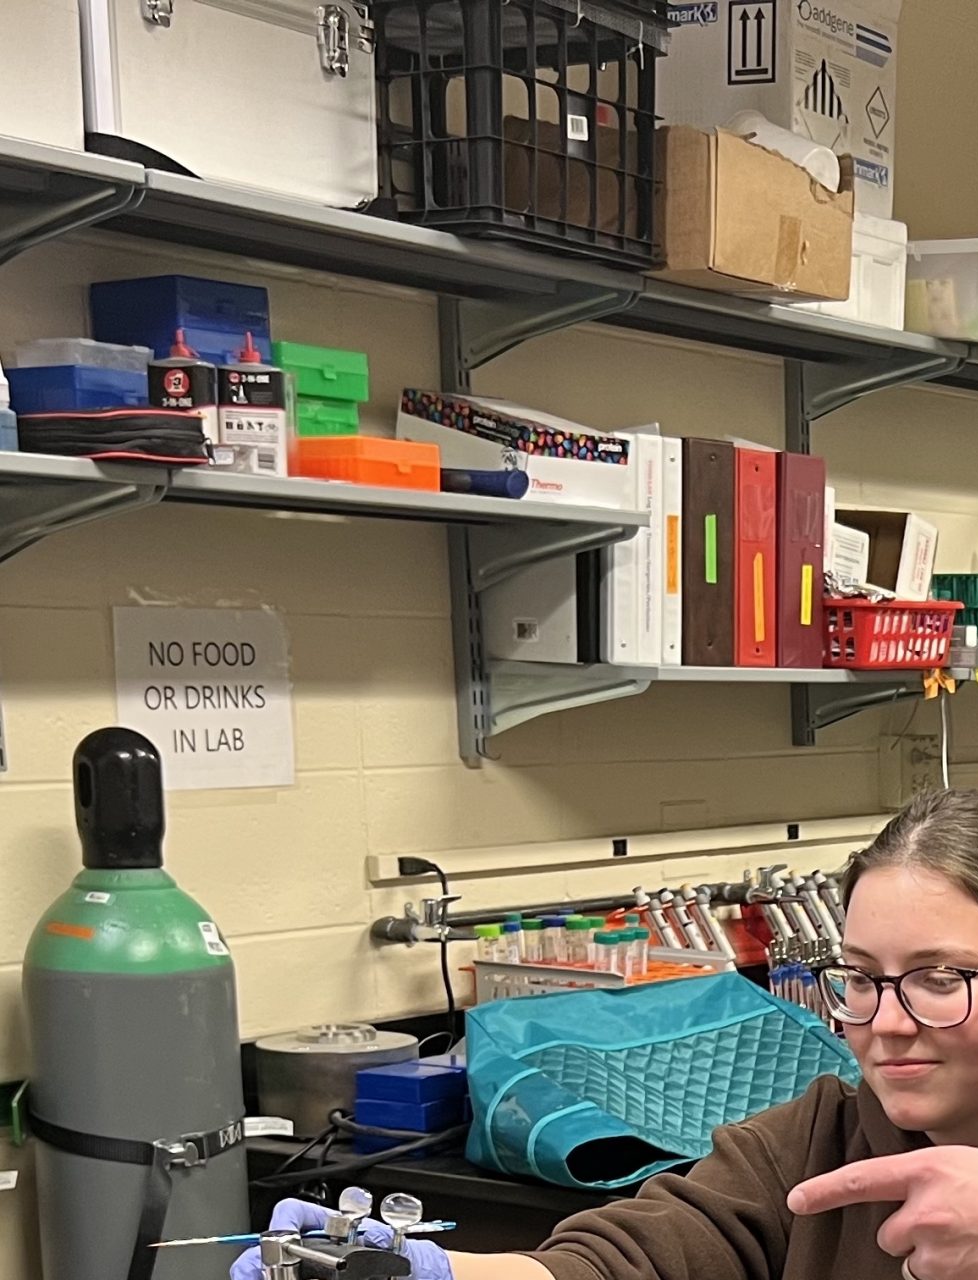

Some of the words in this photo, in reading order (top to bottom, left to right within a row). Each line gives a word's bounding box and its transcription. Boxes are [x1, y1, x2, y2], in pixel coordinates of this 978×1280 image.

[667, 4, 706, 26] mark
[813, 7, 854, 37] addgene
[531, 478, 563, 492] Thermo
[148, 641, 184, 666] NO
[192, 641, 256, 666] FOOD
[144, 685, 177, 710] OR
[185, 684, 266, 709] DRINKS
[173, 729, 196, 753] IN
[205, 728, 245, 752] LAB
